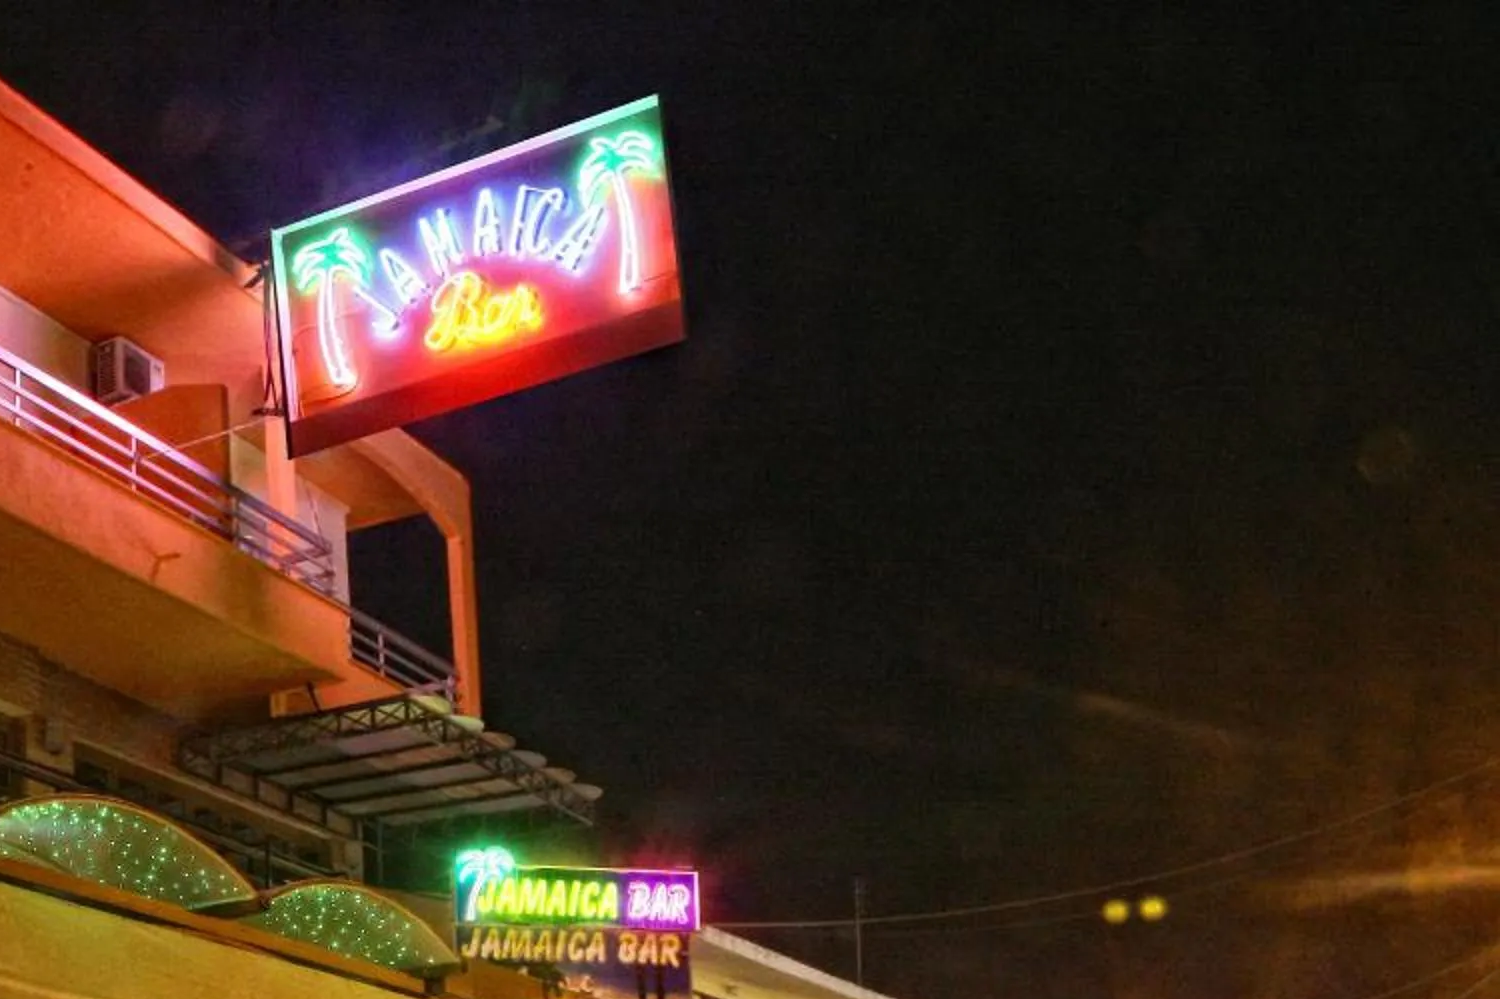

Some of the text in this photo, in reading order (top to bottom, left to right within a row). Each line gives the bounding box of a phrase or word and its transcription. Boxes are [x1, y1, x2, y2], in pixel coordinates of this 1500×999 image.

[353, 184, 607, 336] JAMAICA
[424, 271, 543, 351] Bar
[476, 876, 692, 924] JAMAICA BAR
[460, 927, 682, 968] JAMAICA BAR
